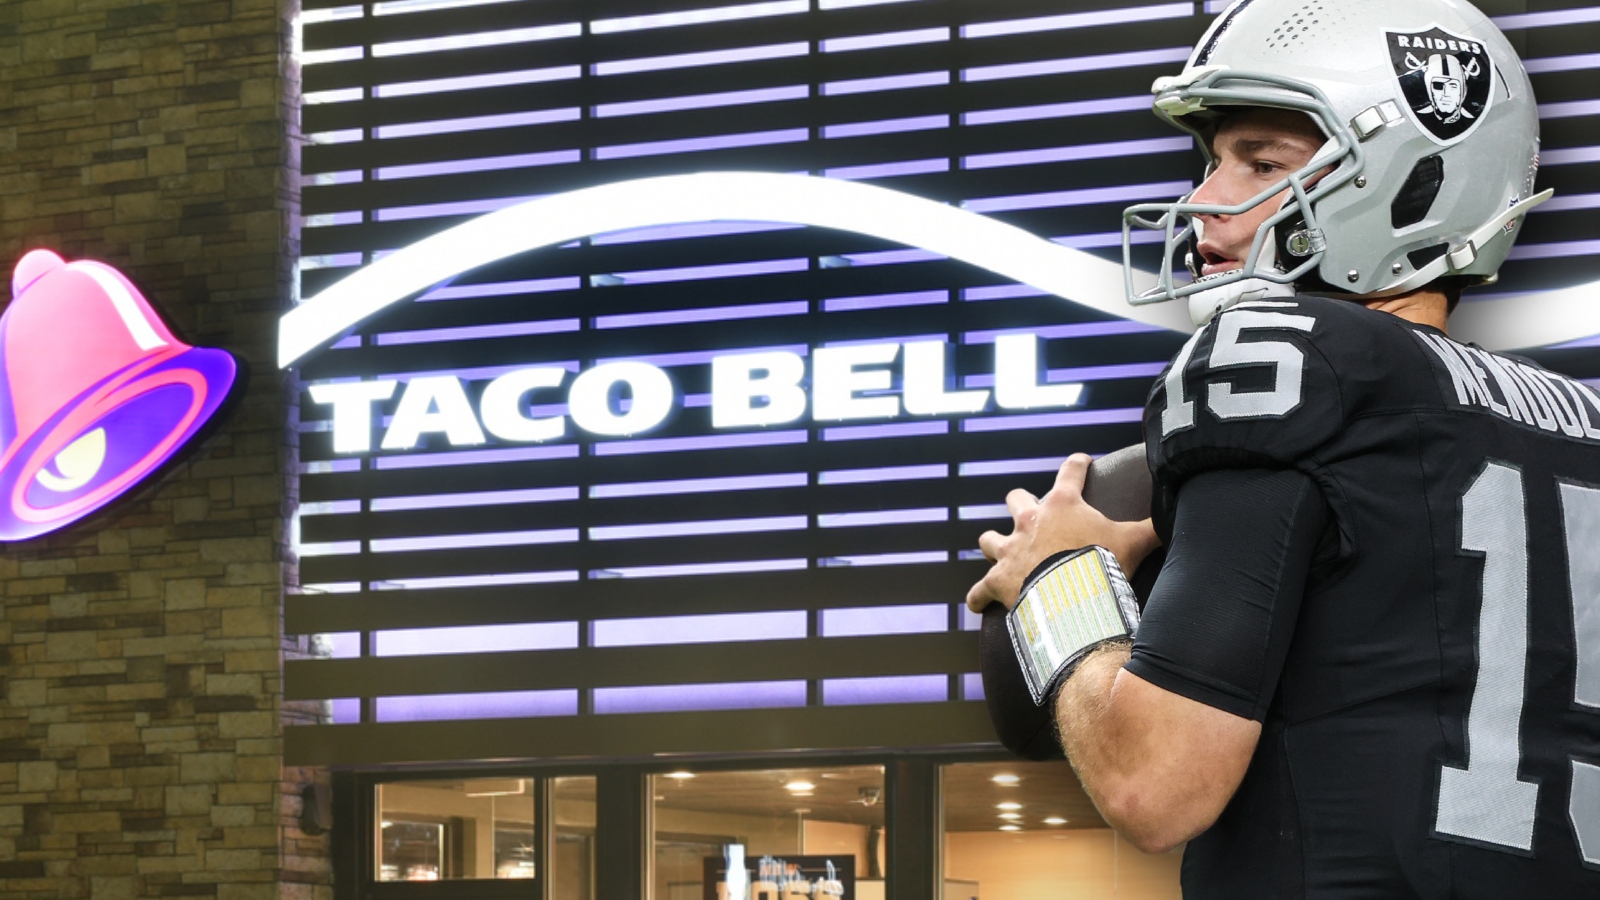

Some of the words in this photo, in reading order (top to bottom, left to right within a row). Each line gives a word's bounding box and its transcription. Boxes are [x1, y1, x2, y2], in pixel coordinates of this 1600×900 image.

[1397, 35, 1481, 54] RAIDERS
[308, 361, 674, 453] TACO
[712, 333, 1083, 428] BELL
[1162, 310, 1316, 436] 15
